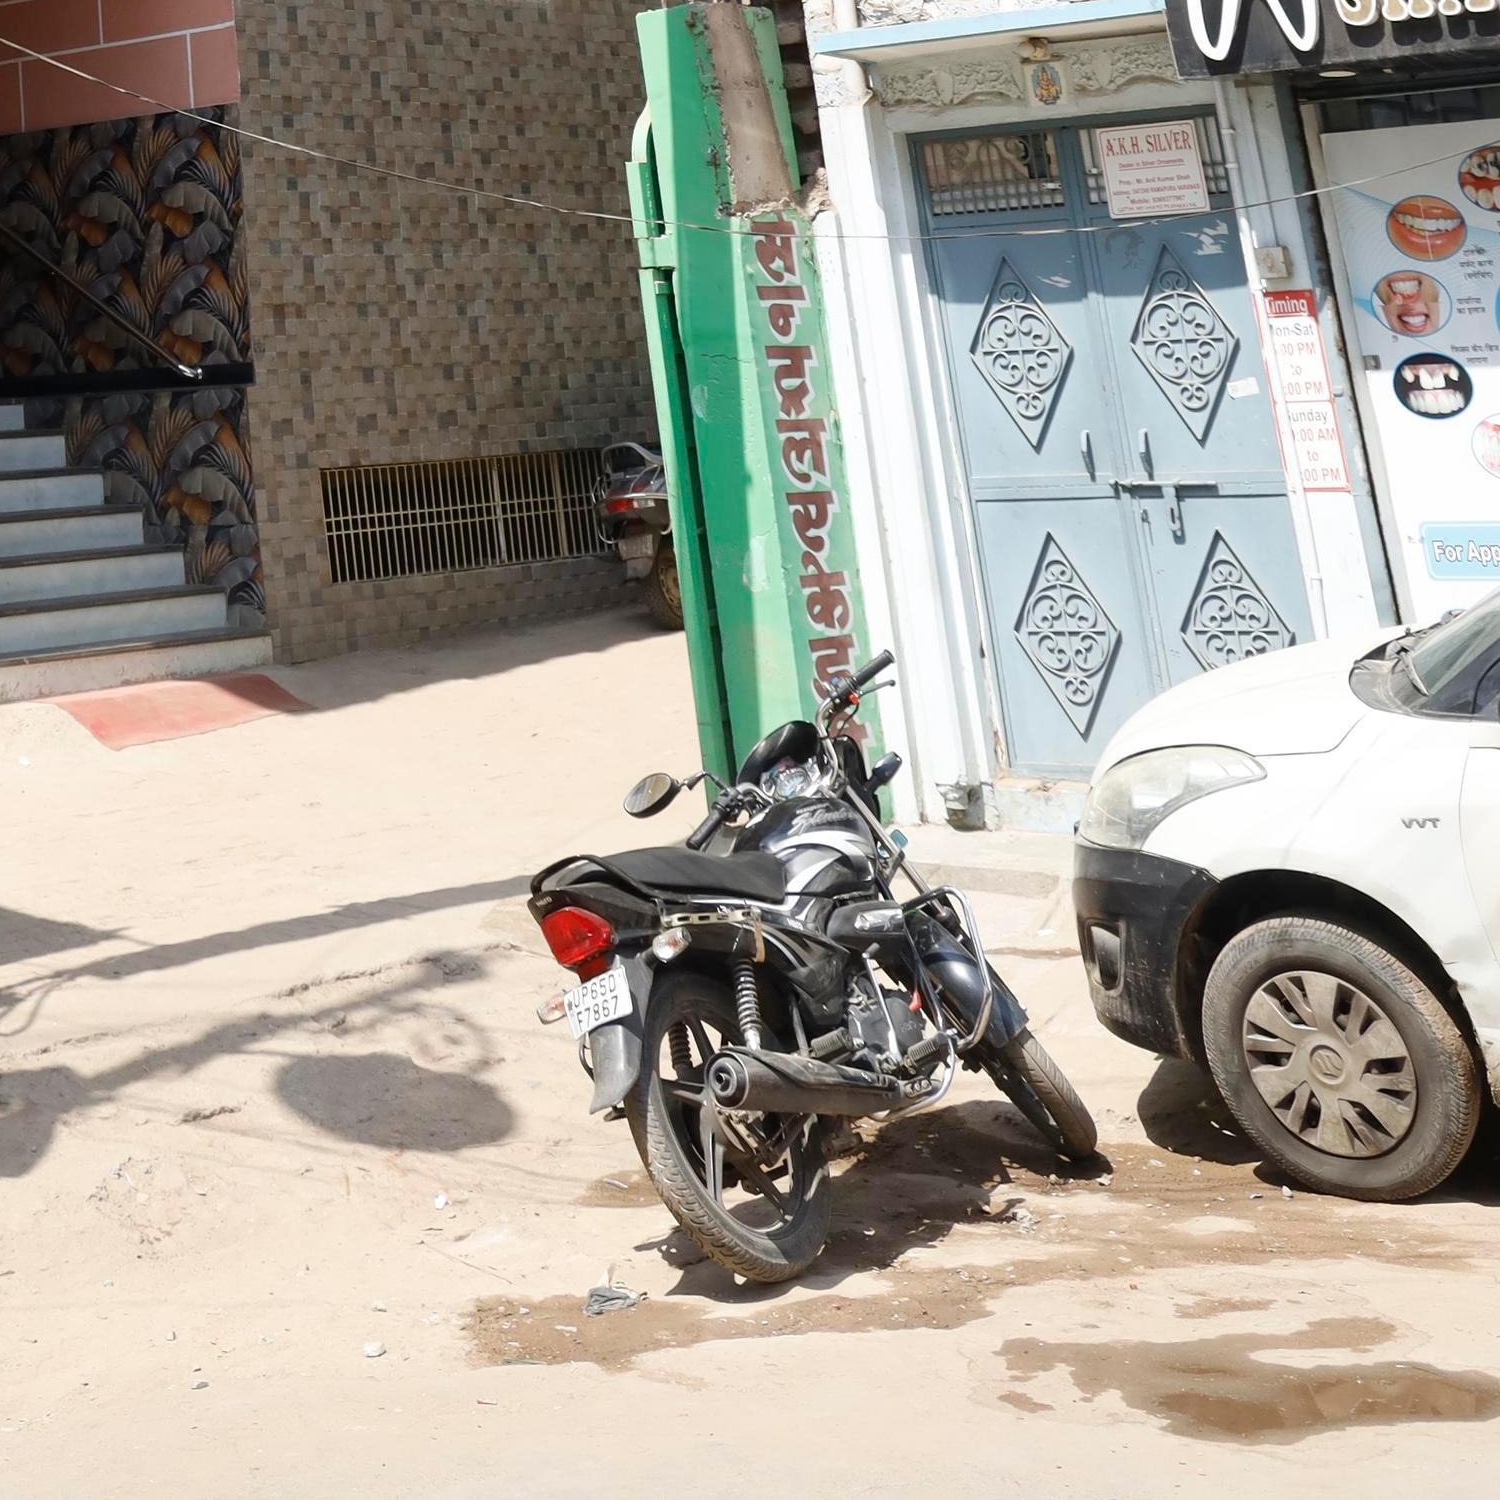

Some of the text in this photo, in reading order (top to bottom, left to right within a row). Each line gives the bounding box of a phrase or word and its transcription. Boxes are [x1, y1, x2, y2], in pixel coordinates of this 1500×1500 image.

[1145, 129, 1192, 153] SILVER
[1270, 322, 1315, 337] on-Sat
[1298, 341, 1316, 355] PM
[1290, 363, 1302, 376] to
[1305, 381, 1323, 395] PM
[1317, 428, 1337, 441] AM
[1307, 450, 1319, 462] to
[1322, 469, 1341, 482] PM
[1432, 539, 1464, 562] For
[1400, 817, 1441, 829] VVT
[572, 973, 618, 1009] UP65D
[576, 995, 619, 1033] F7867
